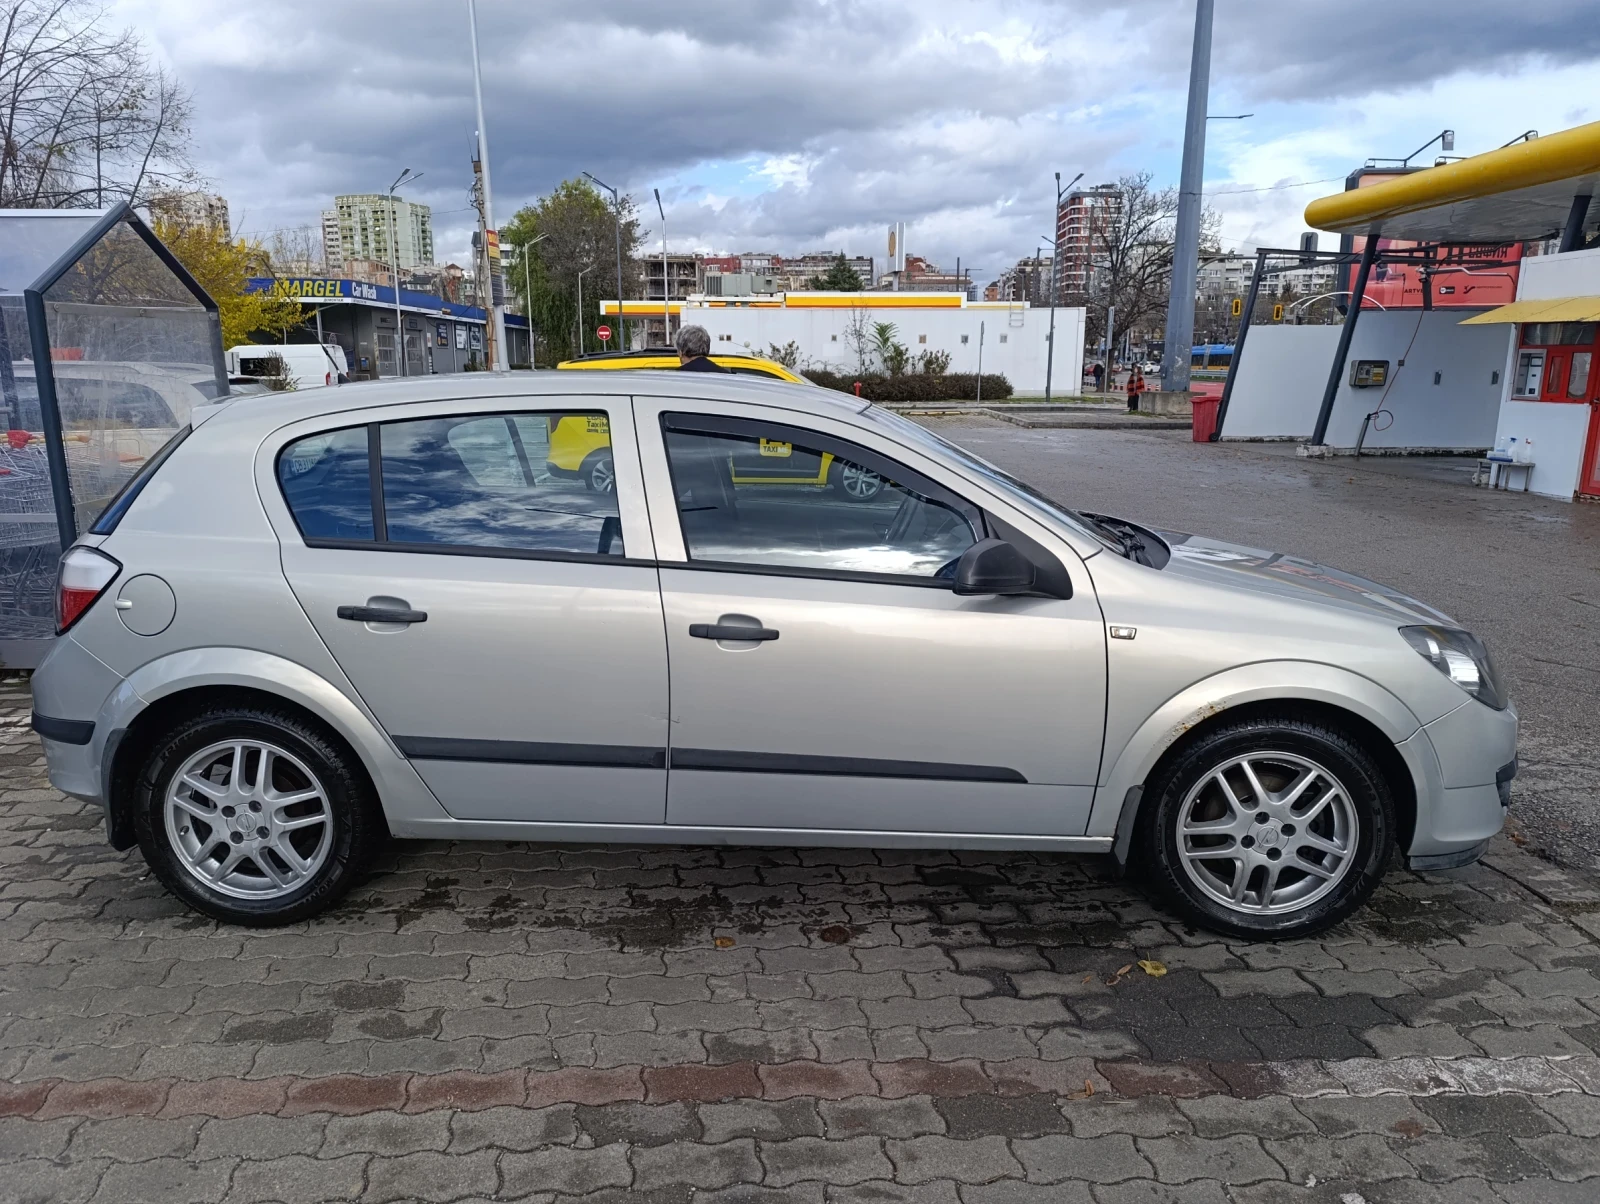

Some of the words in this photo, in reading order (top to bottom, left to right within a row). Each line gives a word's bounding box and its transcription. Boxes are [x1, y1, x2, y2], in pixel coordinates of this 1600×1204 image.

[274, 280, 344, 297] MARGEL
[351, 281, 361, 297] Car
[361, 284, 377, 300] Wash
